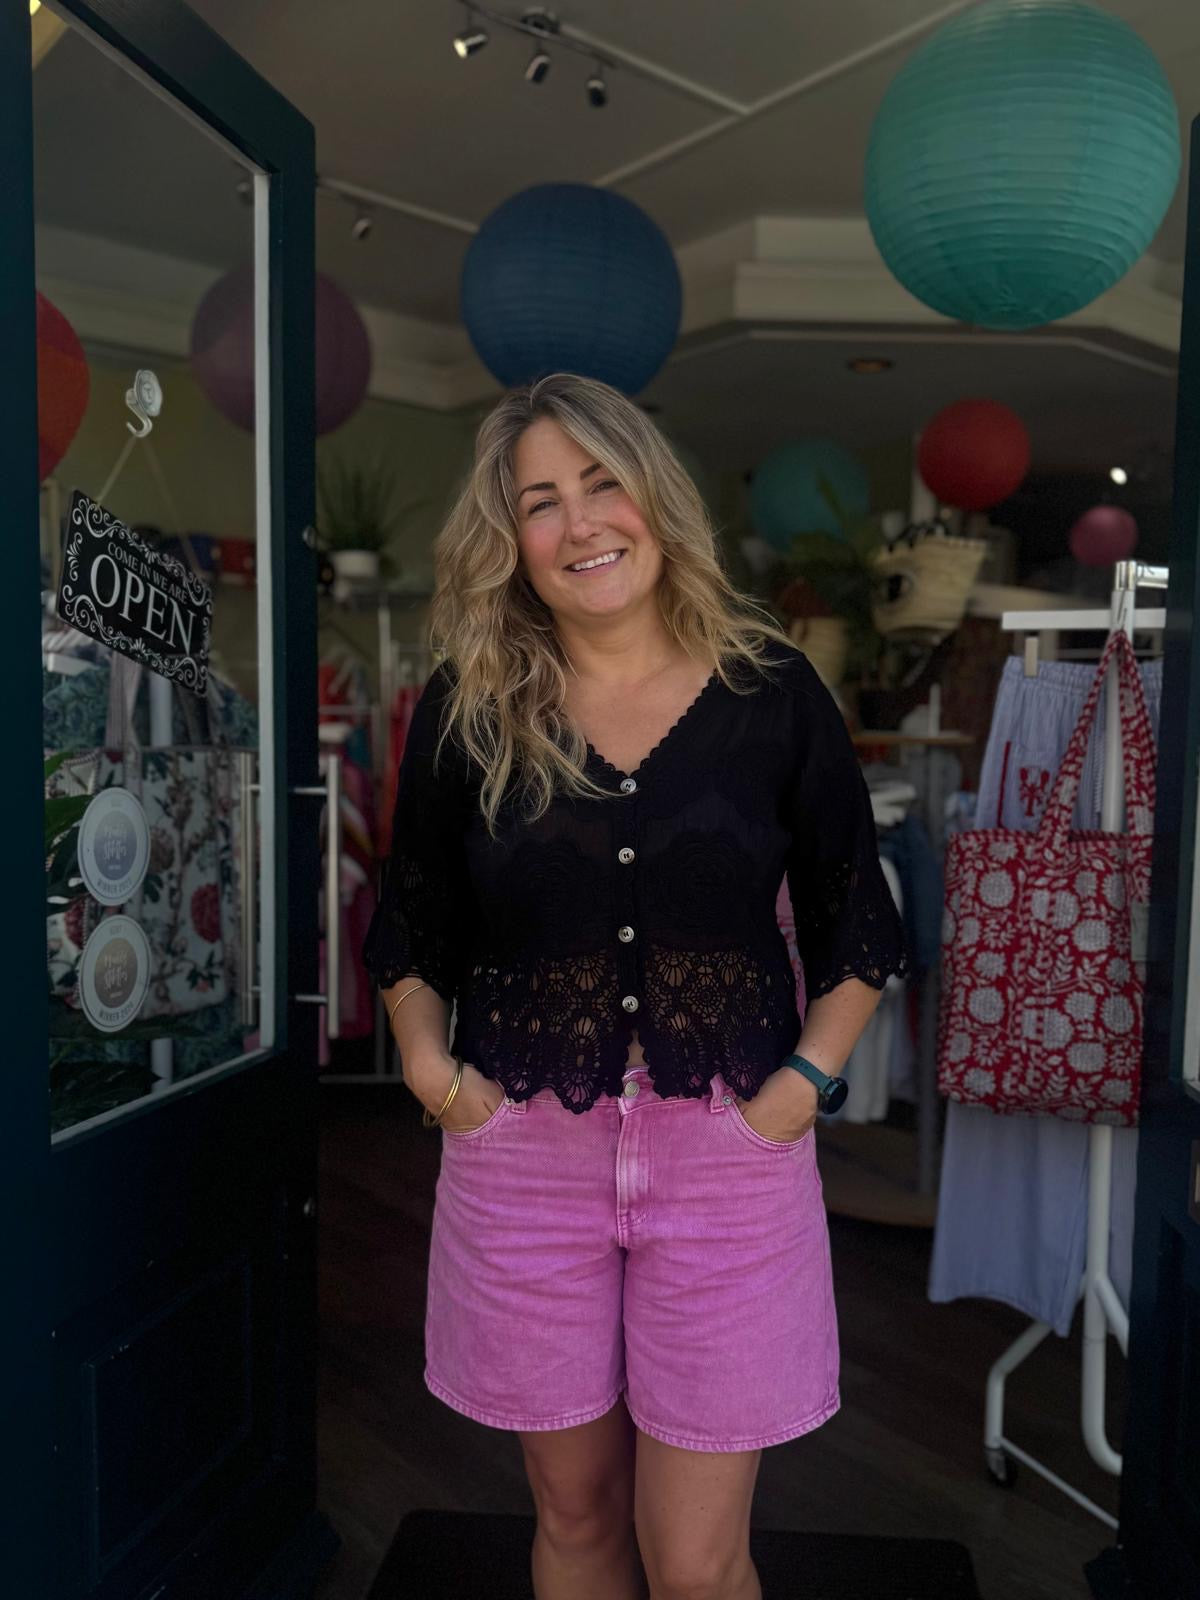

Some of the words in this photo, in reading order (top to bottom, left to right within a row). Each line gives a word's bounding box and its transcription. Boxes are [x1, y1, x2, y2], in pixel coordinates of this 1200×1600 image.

[90, 554, 196, 657] OPEN
[107, 542, 138, 571] COME
[140, 562, 152, 579] IN
[153, 570, 168, 591] WE
[169, 583, 188, 604] ARE
